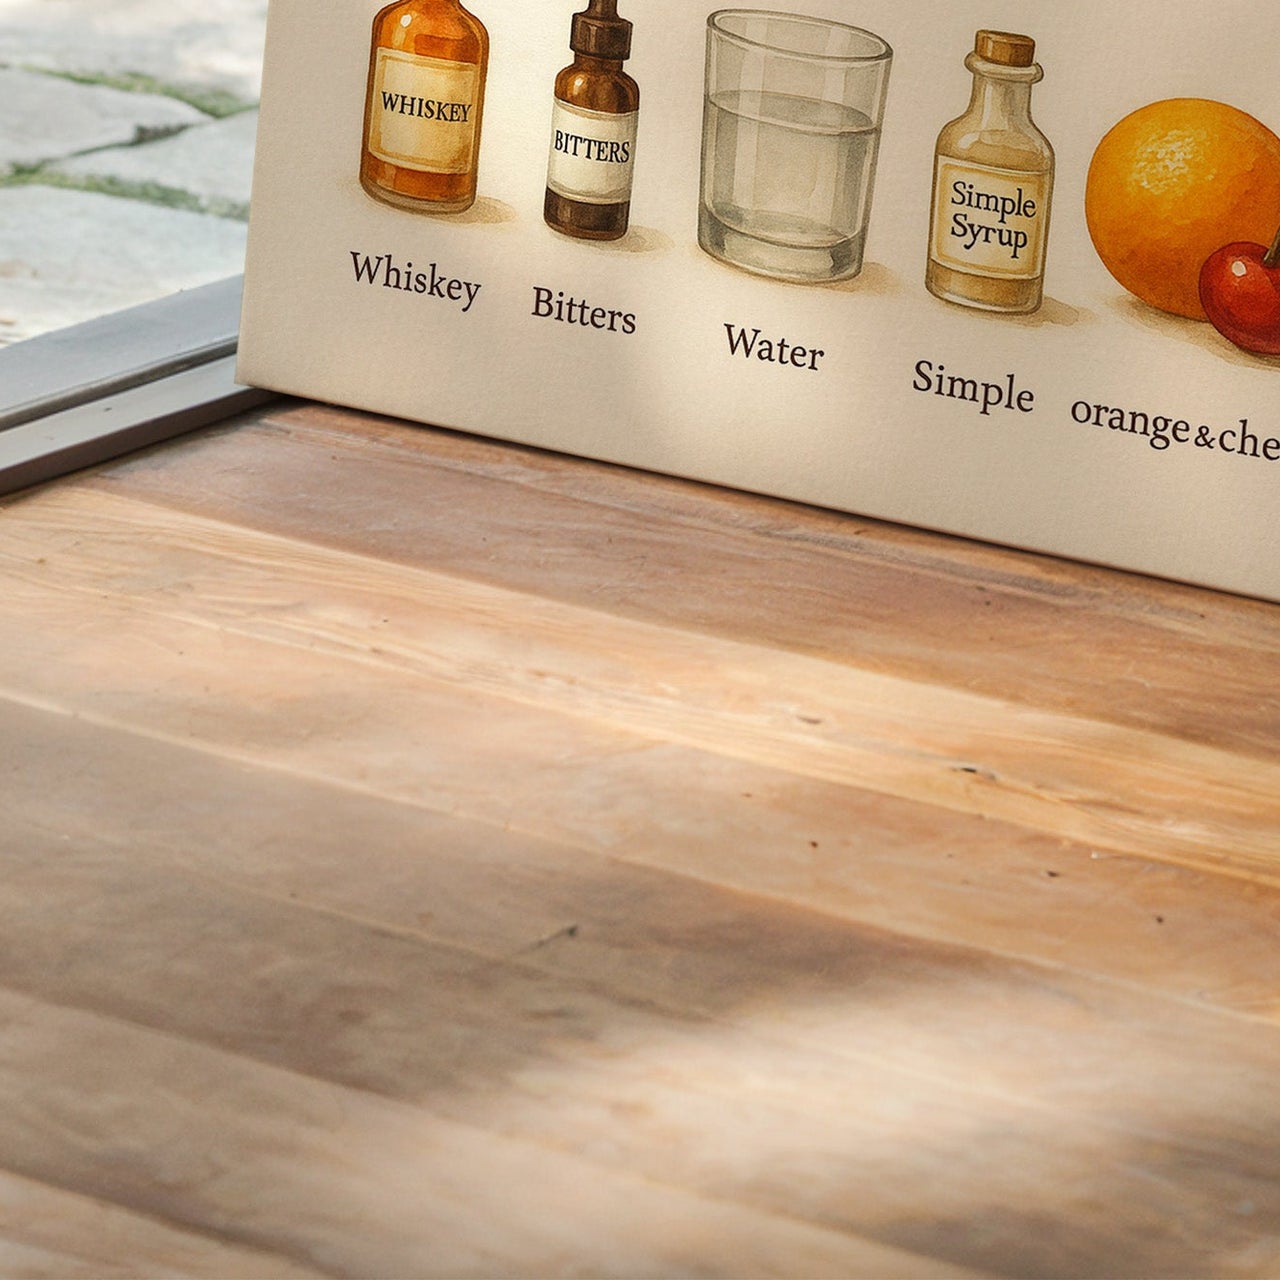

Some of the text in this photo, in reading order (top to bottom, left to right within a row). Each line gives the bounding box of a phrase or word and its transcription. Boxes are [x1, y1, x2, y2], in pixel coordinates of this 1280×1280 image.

[380, 90, 473, 123] WHISKEY
[553, 129, 631, 165] BITTERS
[950, 180, 1037, 223] Simple
[950, 213, 1028, 259] Syrup
[349, 250, 482, 313] Whiskey
[530, 286, 636, 335] Bitters
[723, 322, 825, 372] Water
[912, 359, 1035, 416] Simple
